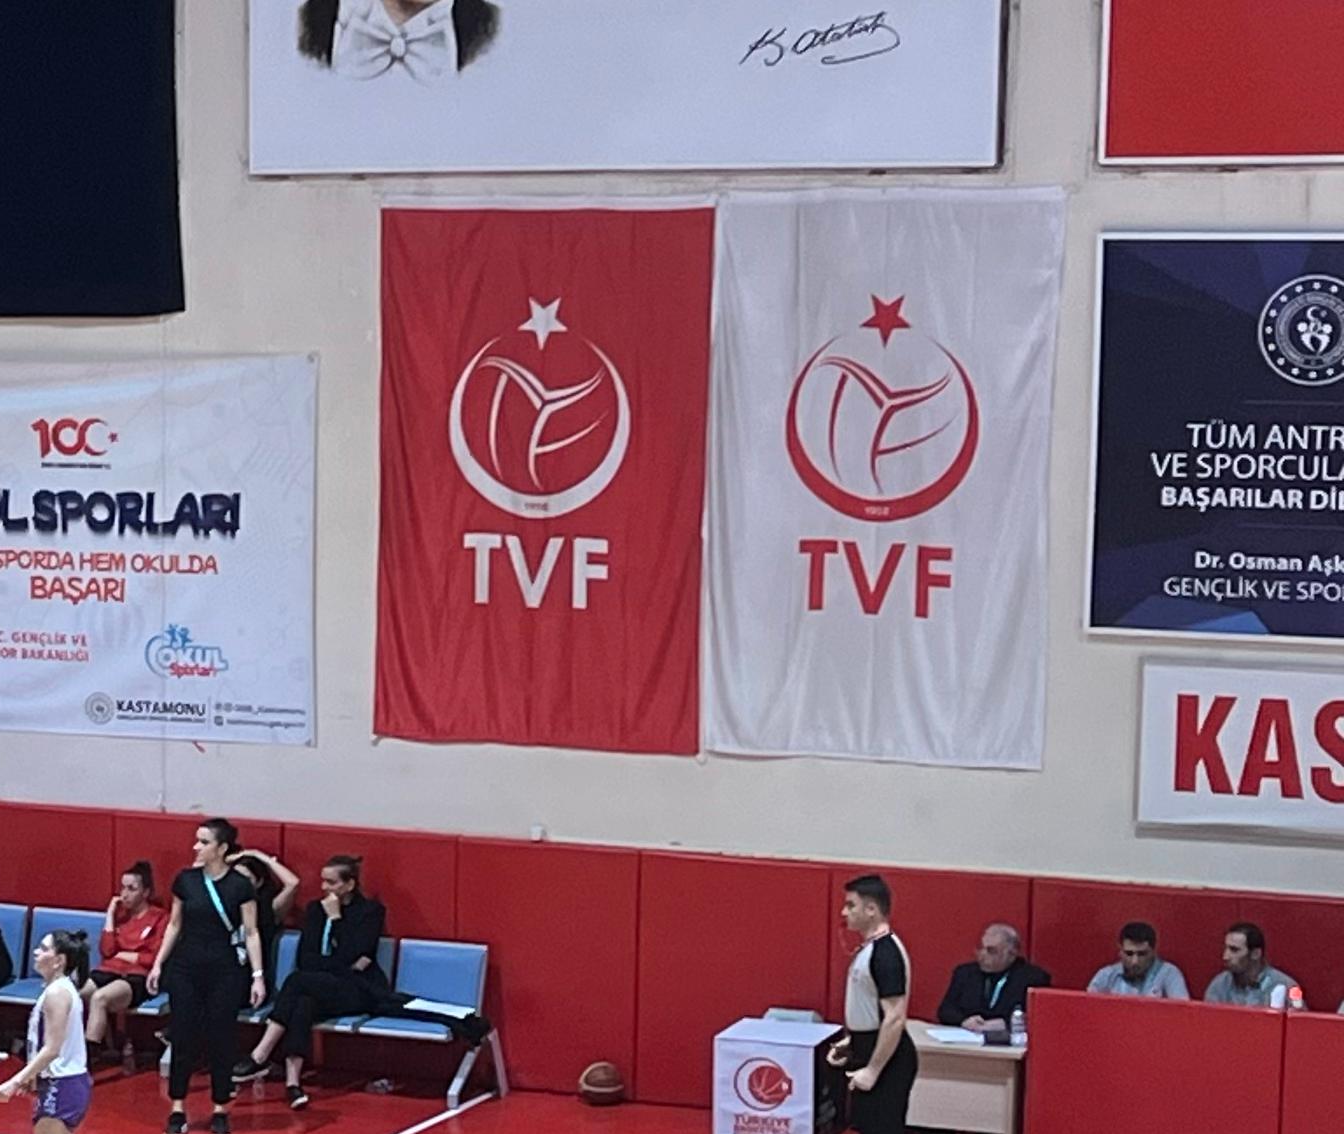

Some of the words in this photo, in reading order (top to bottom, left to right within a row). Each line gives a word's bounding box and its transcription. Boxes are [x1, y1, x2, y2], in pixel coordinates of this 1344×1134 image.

[1186, 419, 1255, 449] TÜM
[1151, 452, 1188, 478] VE
[1196, 453, 1344, 480] SPORCUL
[1161, 486, 1303, 512] BAŞARILAR
[32, 490, 242, 538] SPORLARI
[79, 553, 126, 572] HEM
[130, 553, 219, 575] OKULDA
[463, 533, 610, 610] TVF
[1195, 551, 1225, 570] Dr.
[1229, 552, 1302, 572] Osman
[30, 575, 127, 605] BAŞARI
[799, 539, 953, 618] TVF
[1163, 575, 1259, 602] GENÇLİK
[1263, 580, 1291, 600] VE
[1296, 582, 1344, 602] SPO
[116, 699, 206, 718] KASTAMONU
[1174, 694, 1344, 804] KAS
